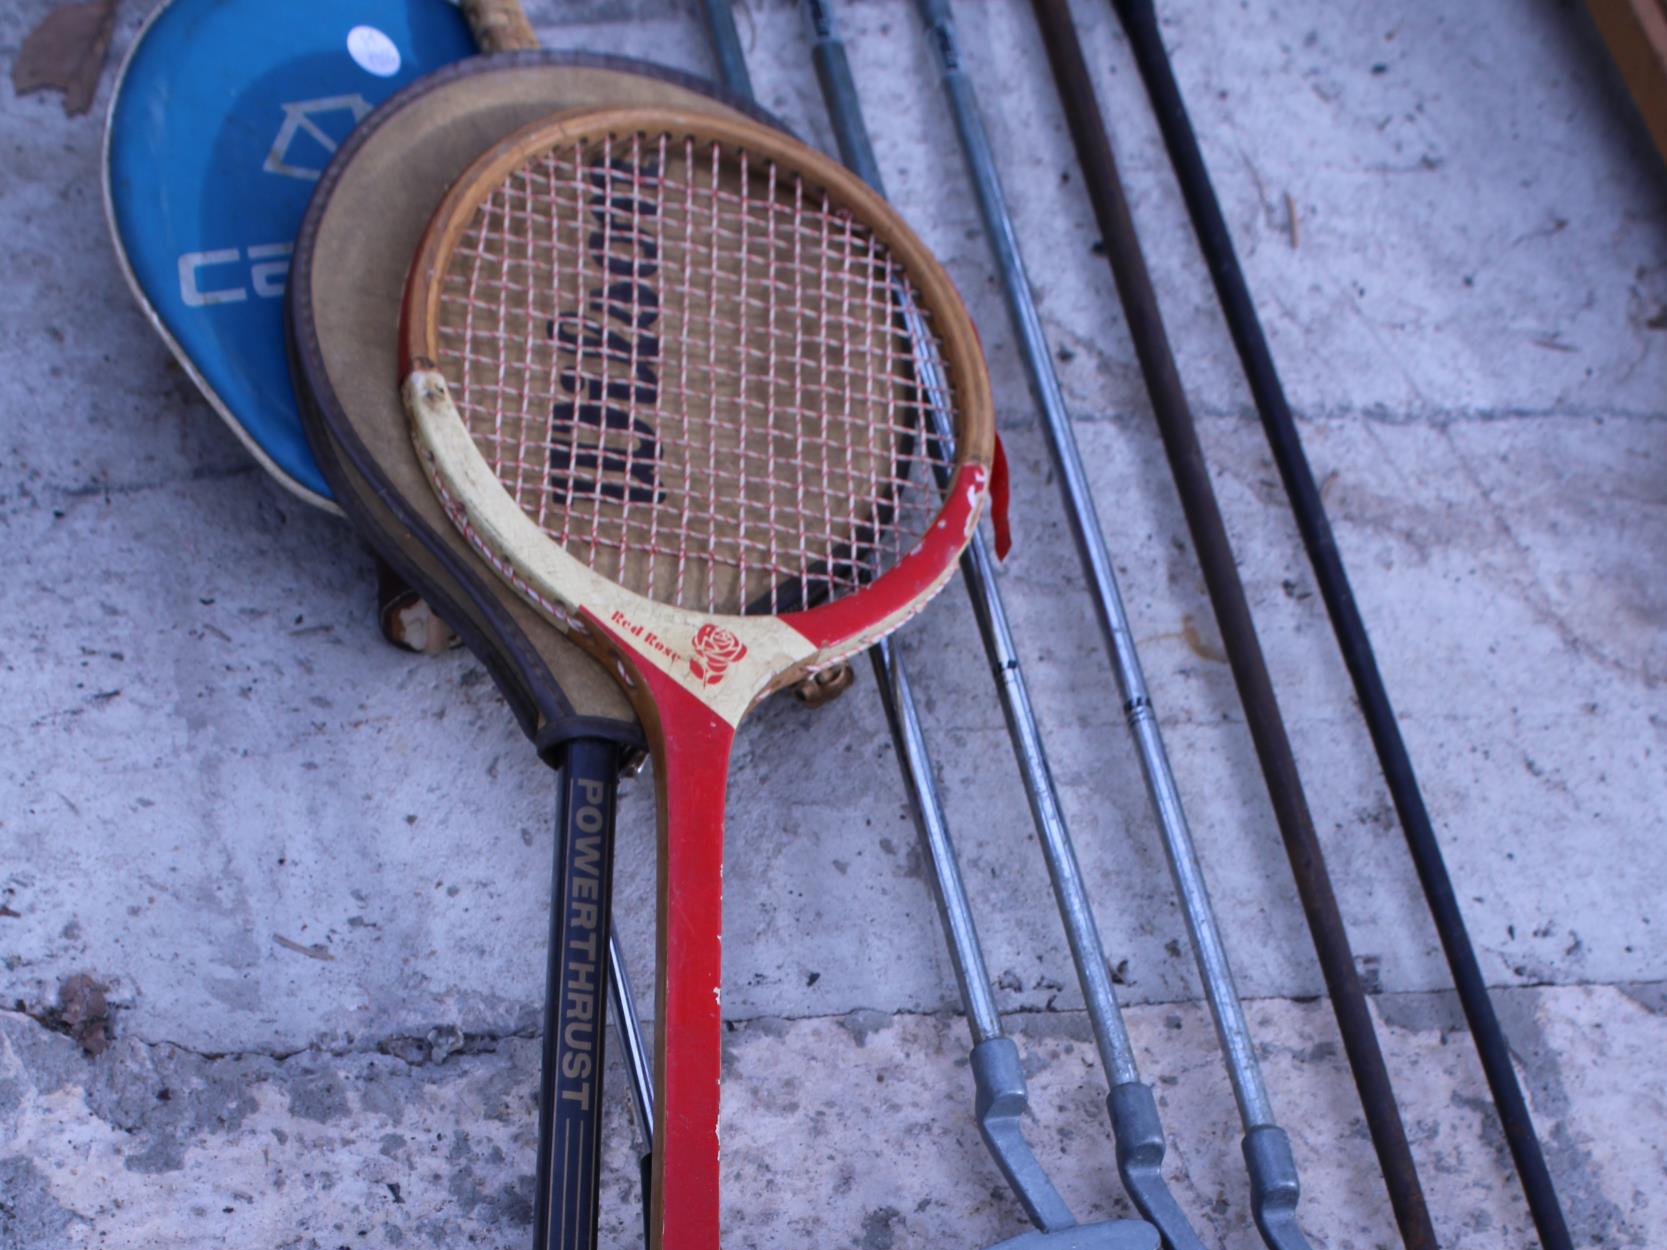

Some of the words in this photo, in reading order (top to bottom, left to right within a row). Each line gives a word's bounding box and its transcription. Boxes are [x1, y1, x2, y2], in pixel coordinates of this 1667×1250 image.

[547, 157, 666, 505] Wilson
[611, 610, 644, 638] Red
[643, 632, 681, 663] Rose
[561, 777, 604, 1112] POWERTHRUST
